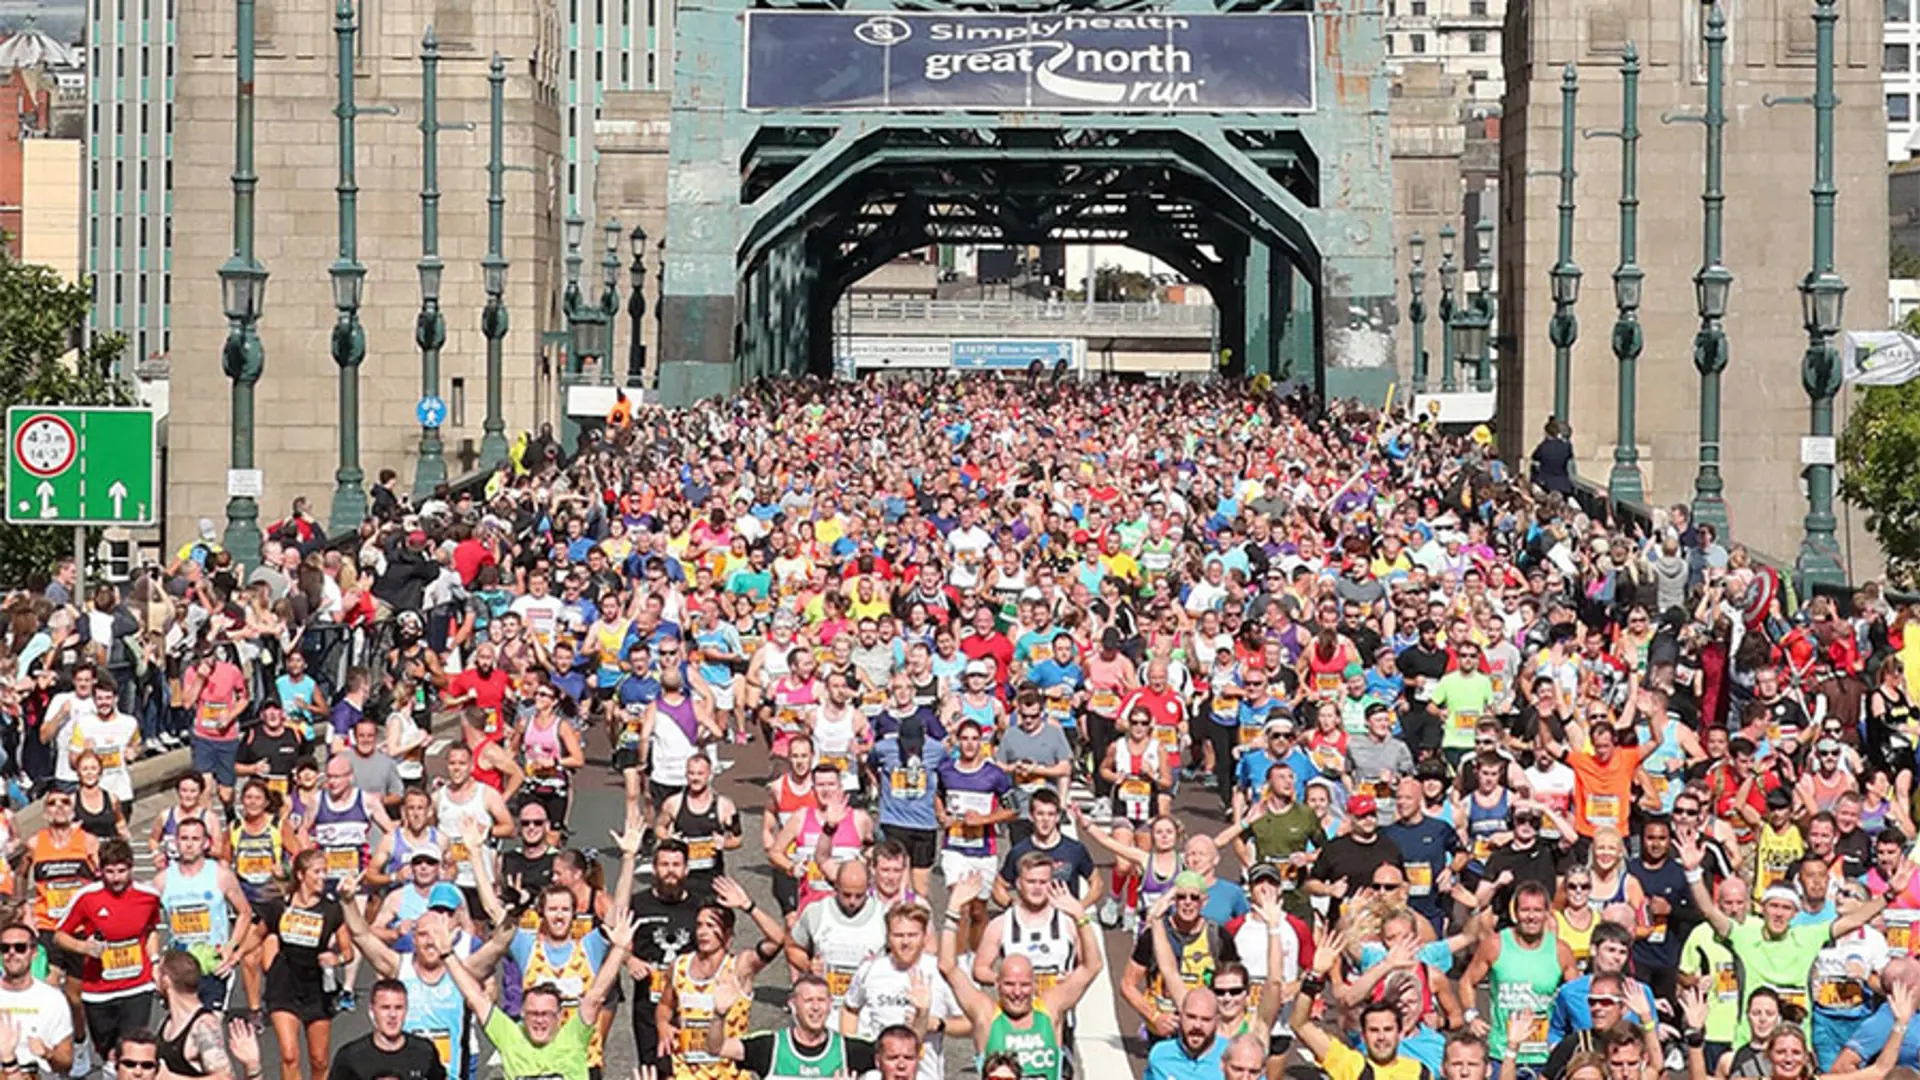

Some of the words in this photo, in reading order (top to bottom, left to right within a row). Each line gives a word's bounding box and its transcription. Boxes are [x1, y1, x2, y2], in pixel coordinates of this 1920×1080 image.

[930, 16, 1189, 42] Simplyhealth
[925, 48, 1034, 80] great
[1076, 44, 1191, 73] north
[1129, 80, 1199, 103] run
